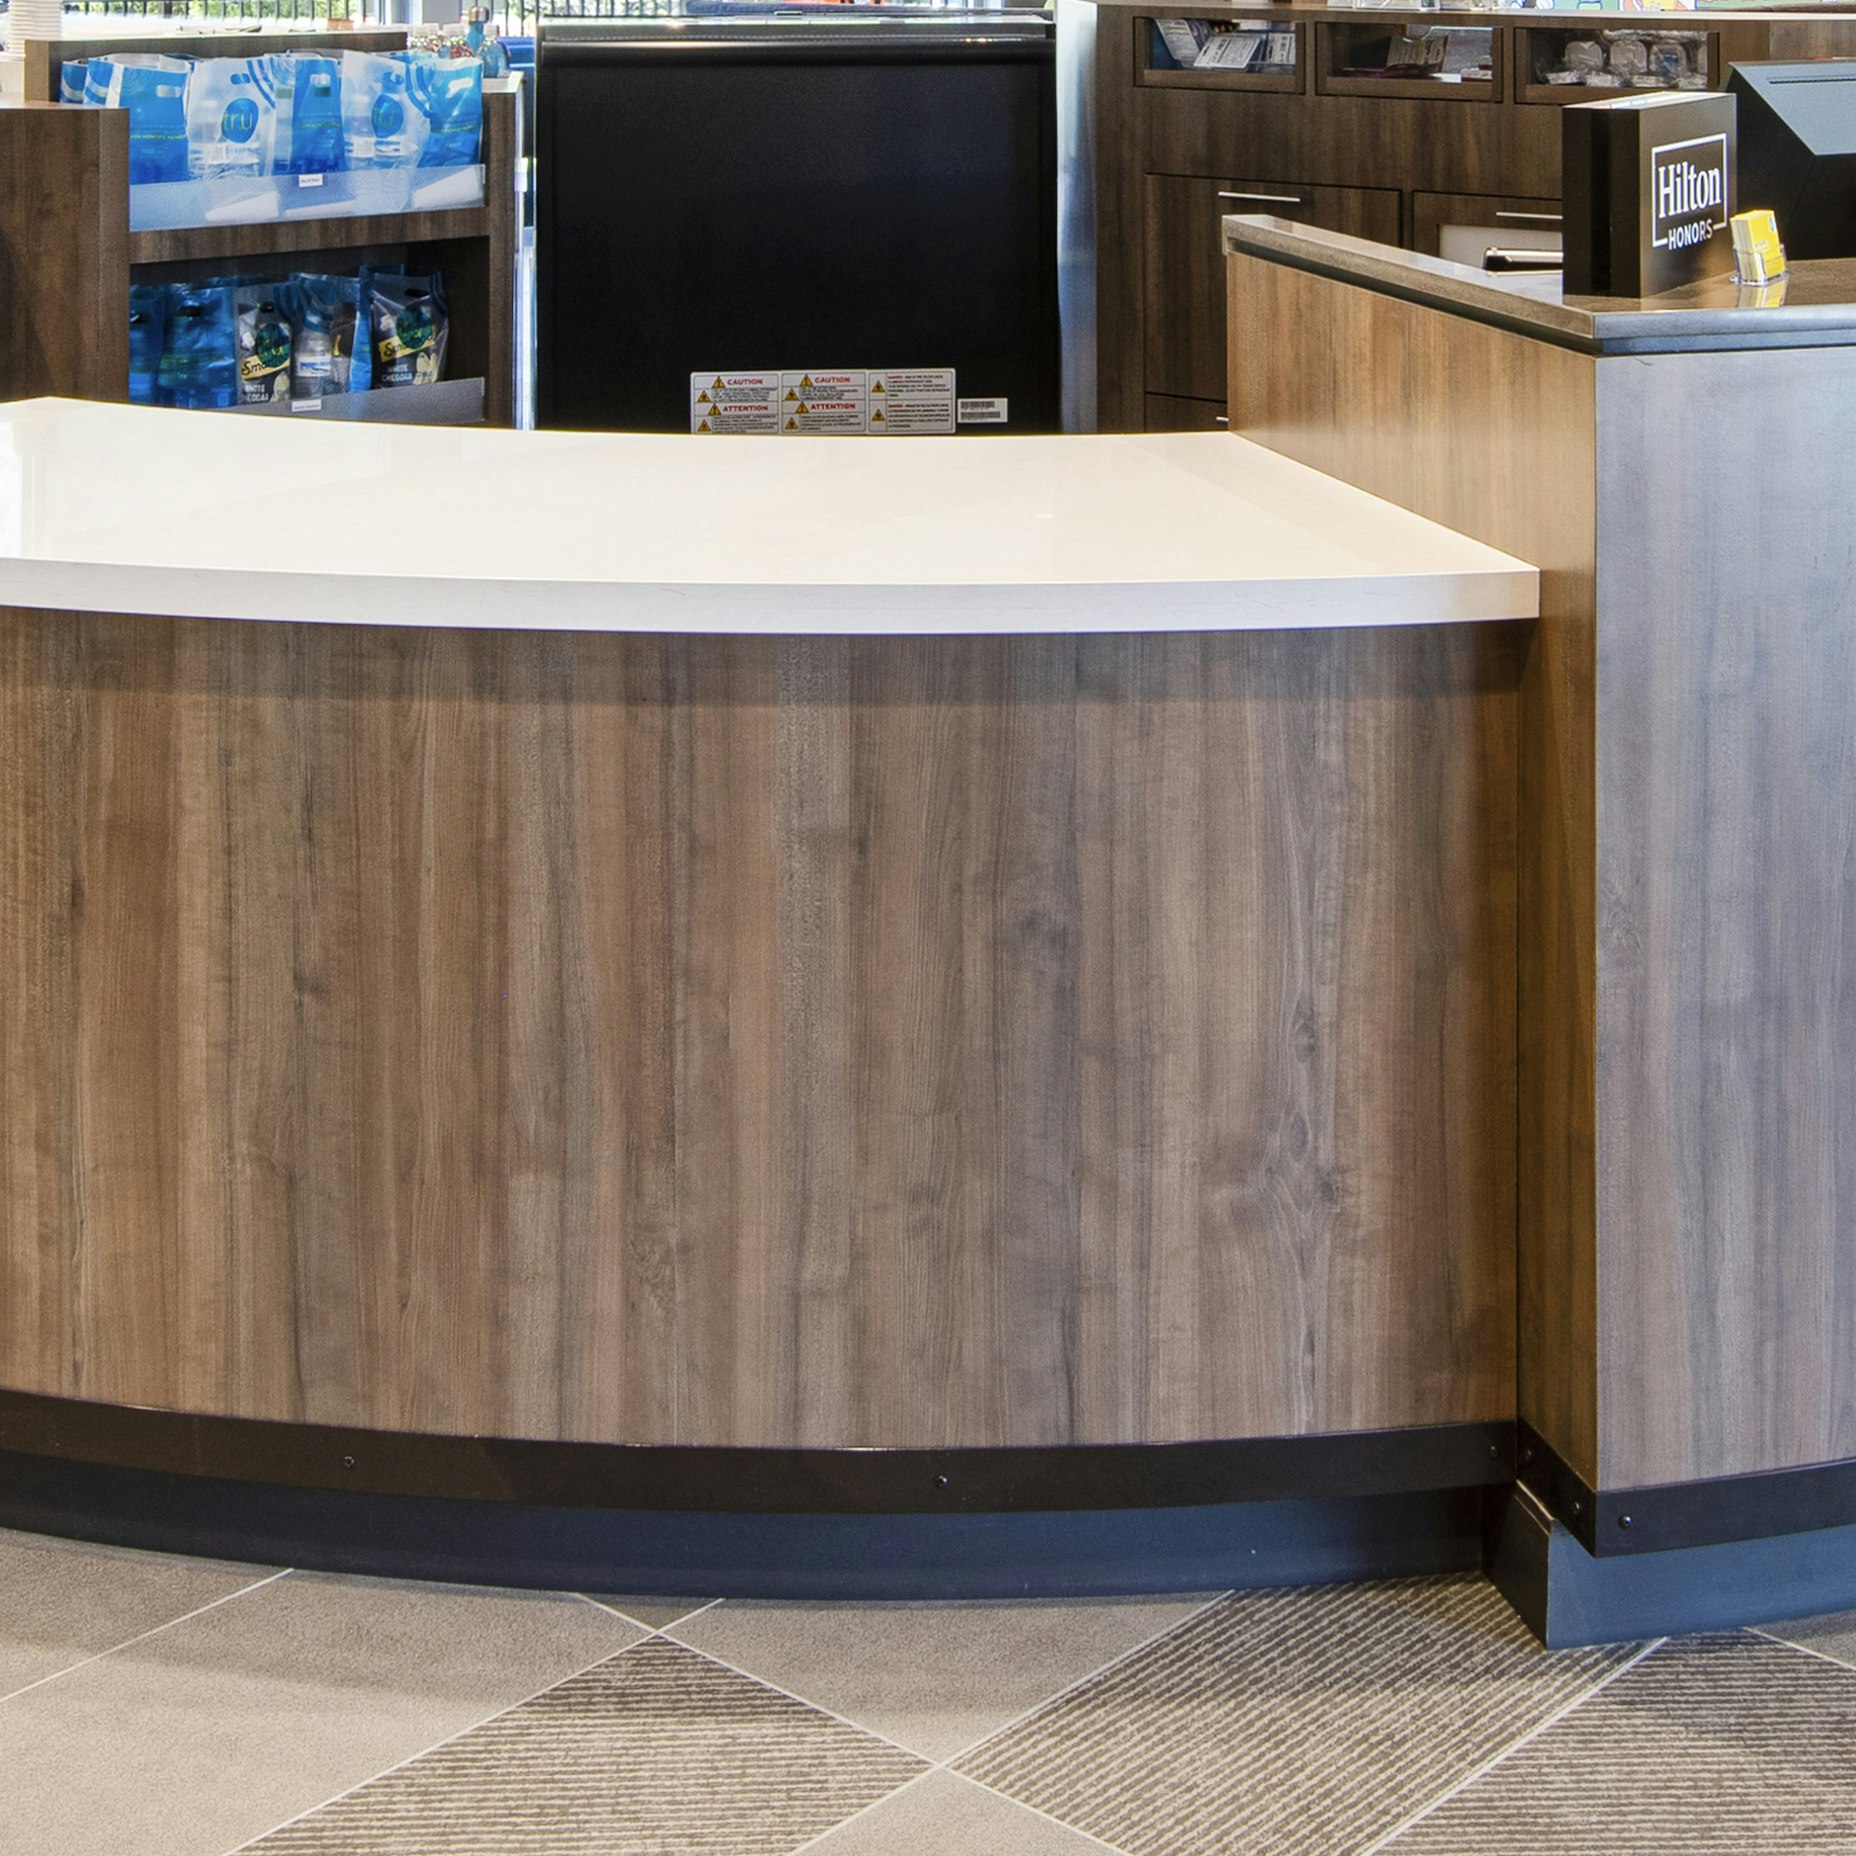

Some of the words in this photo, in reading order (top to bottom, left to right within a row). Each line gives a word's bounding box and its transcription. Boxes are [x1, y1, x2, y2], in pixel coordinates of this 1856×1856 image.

[224, 112, 253, 131] tru
[1658, 161, 1722, 219] Hilton
[1668, 218, 1713, 251] HONORS
[727, 378, 763, 386] CAUTION
[814, 376, 851, 384] CAUTION
[723, 404, 769, 412] ATTENTION
